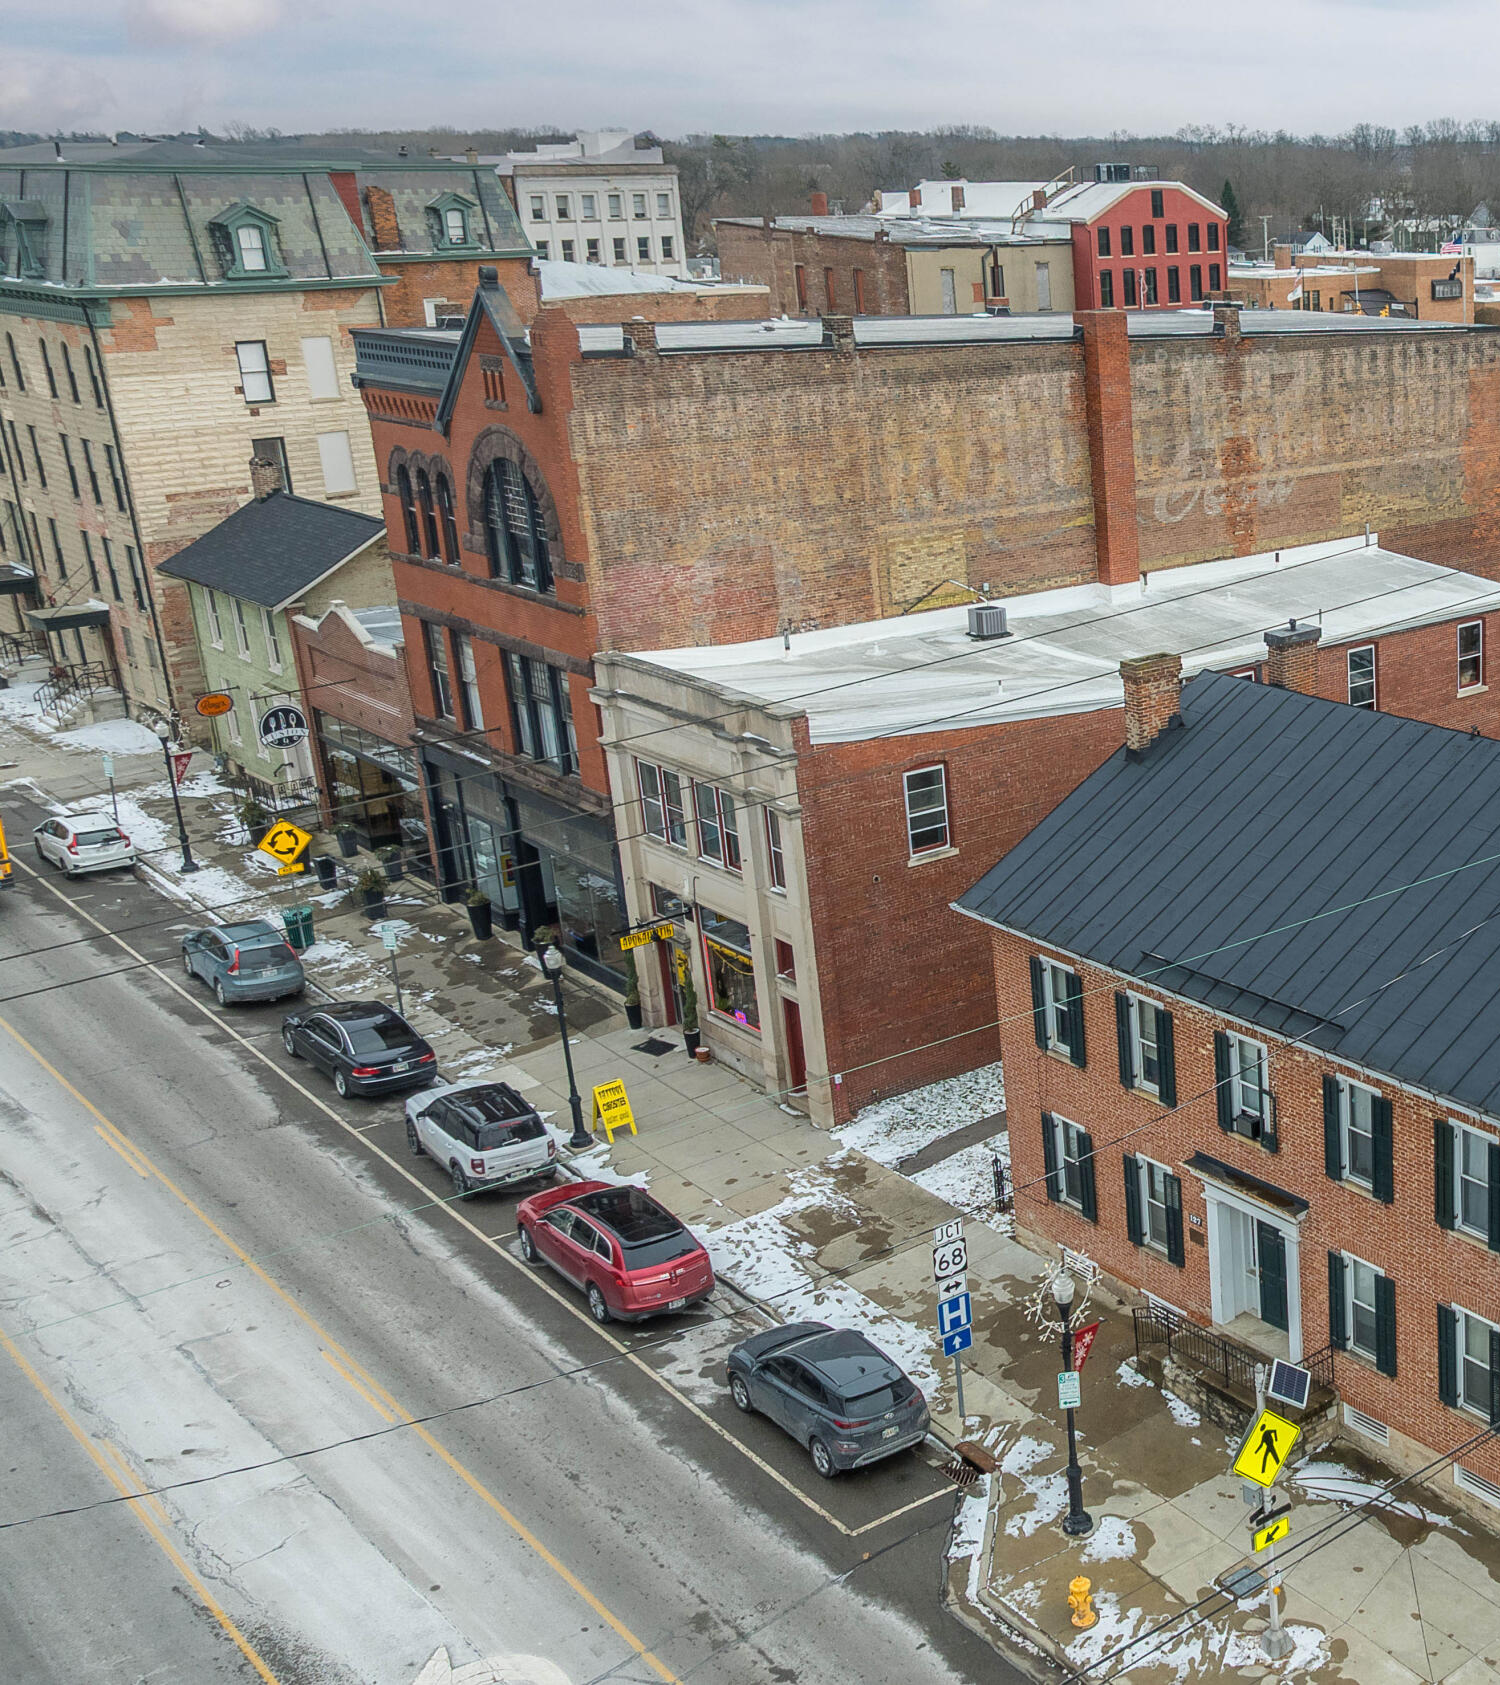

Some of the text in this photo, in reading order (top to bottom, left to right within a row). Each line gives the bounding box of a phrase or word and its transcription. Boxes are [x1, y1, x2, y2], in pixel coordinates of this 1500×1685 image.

[1190, 1214, 1201, 1225] 127
[938, 1221, 961, 1242] JCT
[938, 1247, 963, 1272] 68
[942, 1295, 967, 1333] H
